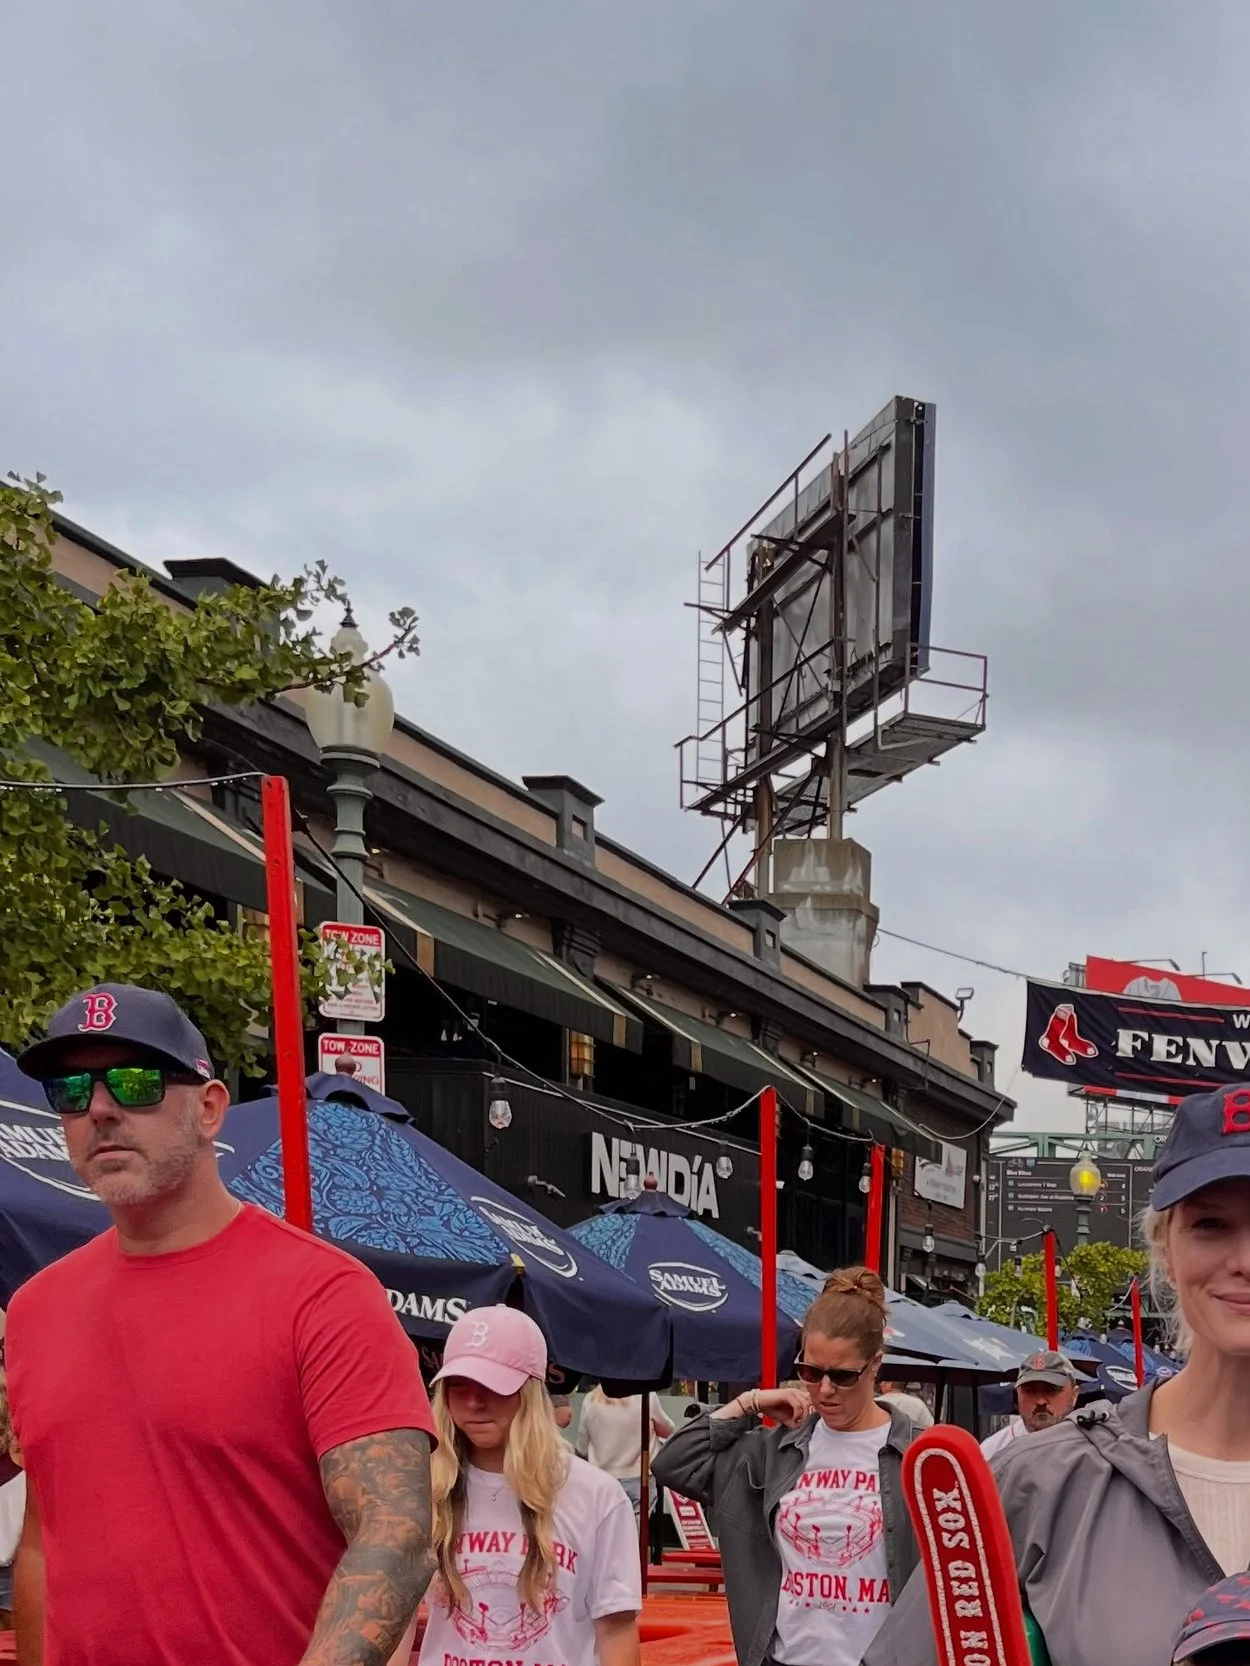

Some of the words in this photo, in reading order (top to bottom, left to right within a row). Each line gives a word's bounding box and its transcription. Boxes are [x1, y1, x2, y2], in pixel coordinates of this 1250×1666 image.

[351, 930, 381, 947] ZONE
[78, 992, 118, 1032] B
[323, 1039, 346, 1052] TOW
[350, 1040, 380, 1056] ZONE
[649, 1269, 726, 1290] SAMUEL
[385, 1288, 468, 1325] DAMS
[464, 1321, 489, 1348] B
[932, 1487, 971, 1550] SOX
[857, 1578, 891, 1603] MA
[947, 1559, 984, 1618] RED
